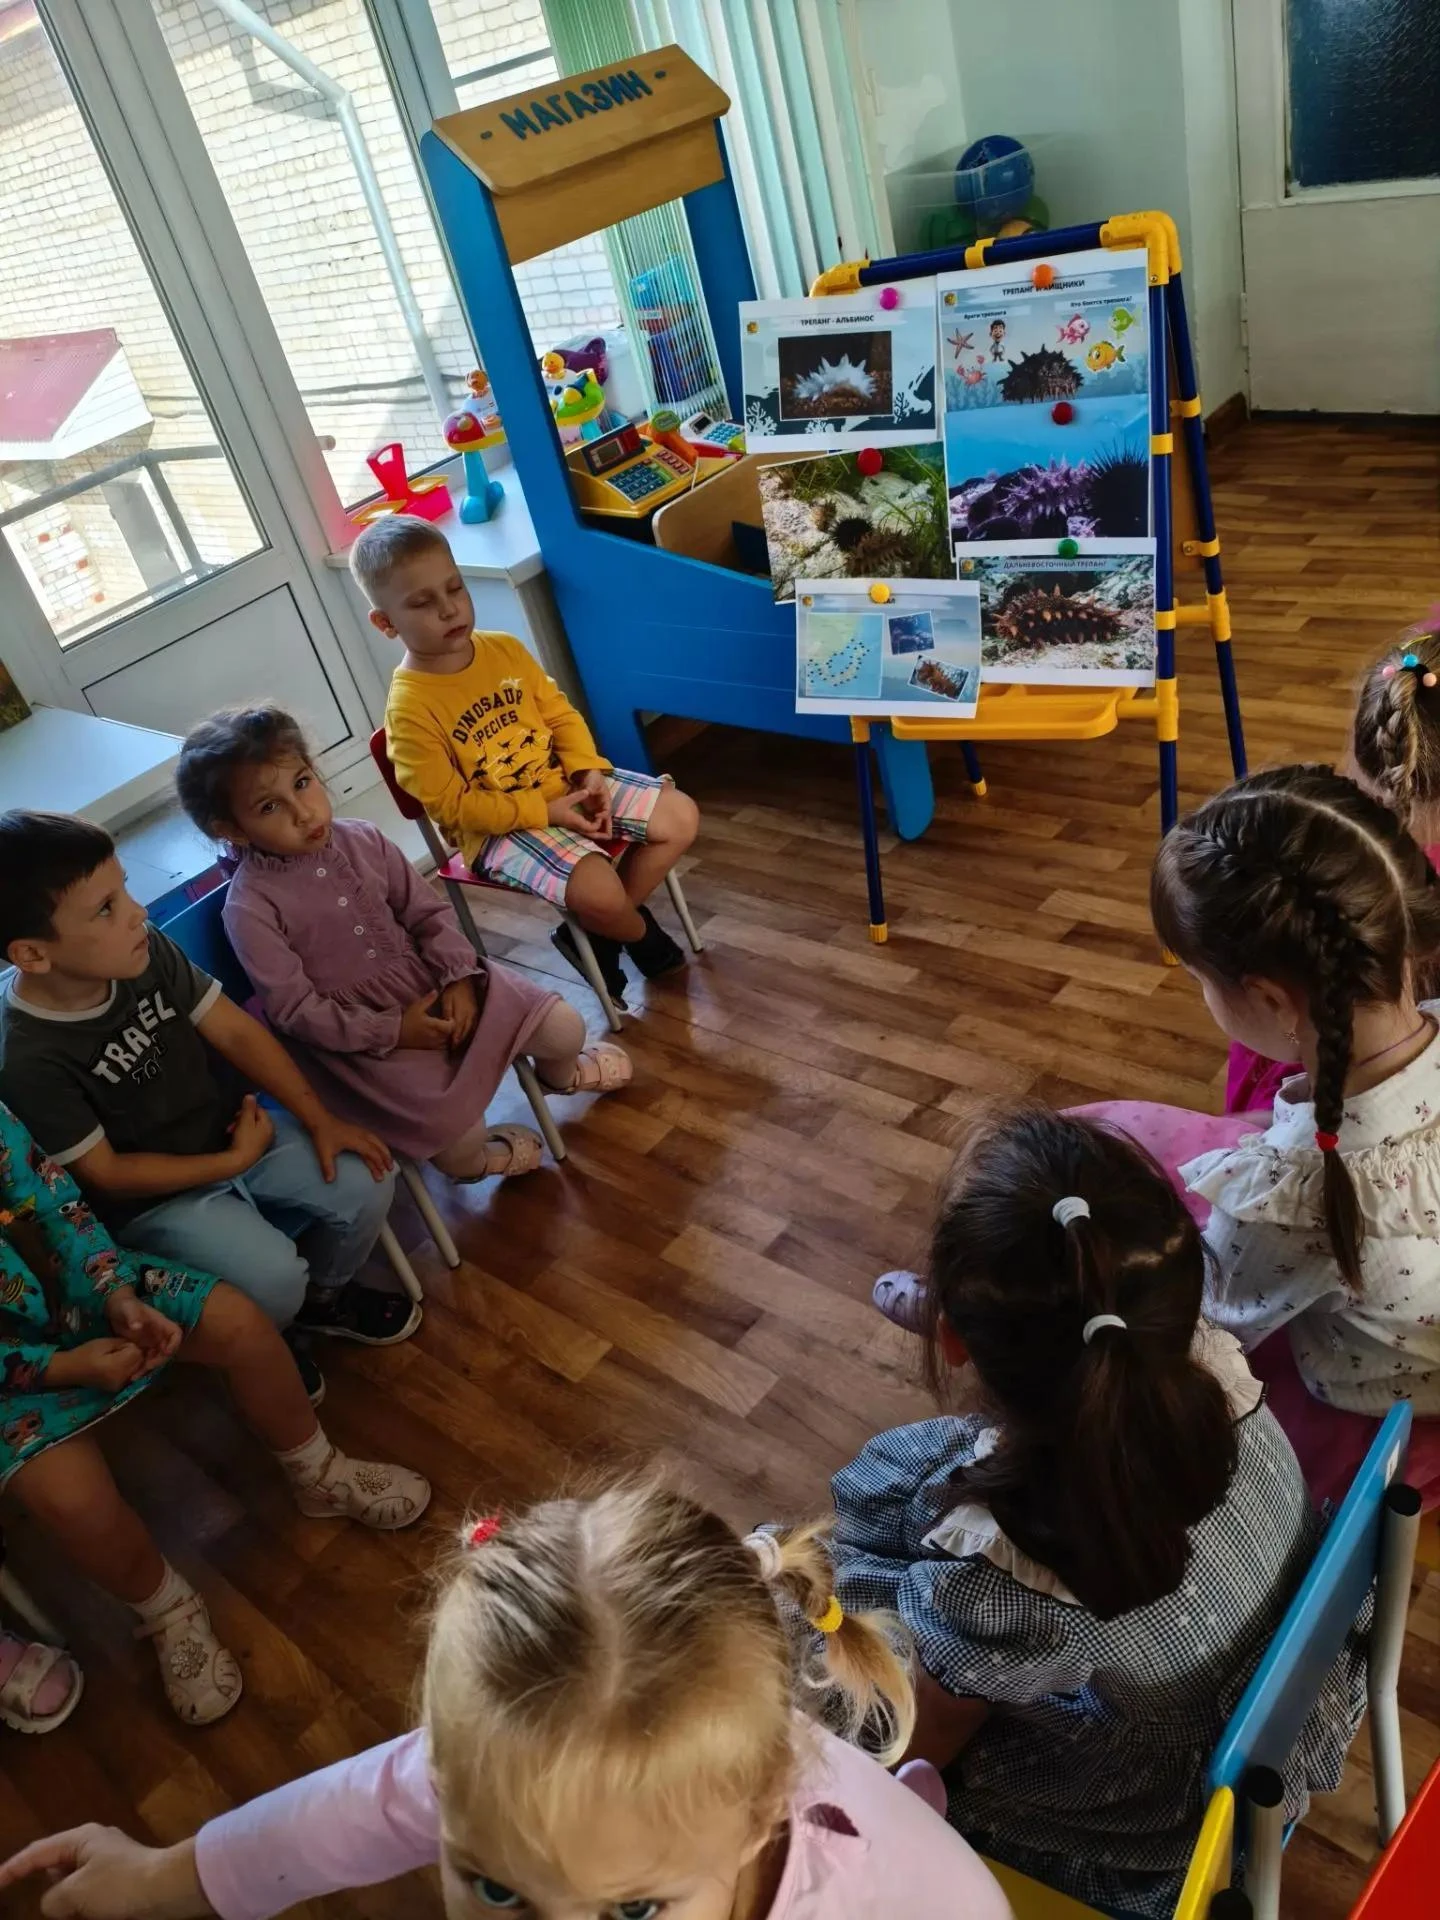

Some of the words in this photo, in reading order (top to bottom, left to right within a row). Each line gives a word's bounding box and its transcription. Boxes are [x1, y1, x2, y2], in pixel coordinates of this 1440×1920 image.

[499, 70, 653, 140] МАГАЗИН
[1002, 286, 1033, 296] ТРЕПАНГ
[801, 317, 831, 326] ТРЕПАНГ
[836, 315, 875, 324] АЛЬБИНОС
[1003, 561, 1076, 569] ДАЛЬНЕВОСТОЧНЫЙ
[472, 710, 518, 748] SPECIES
